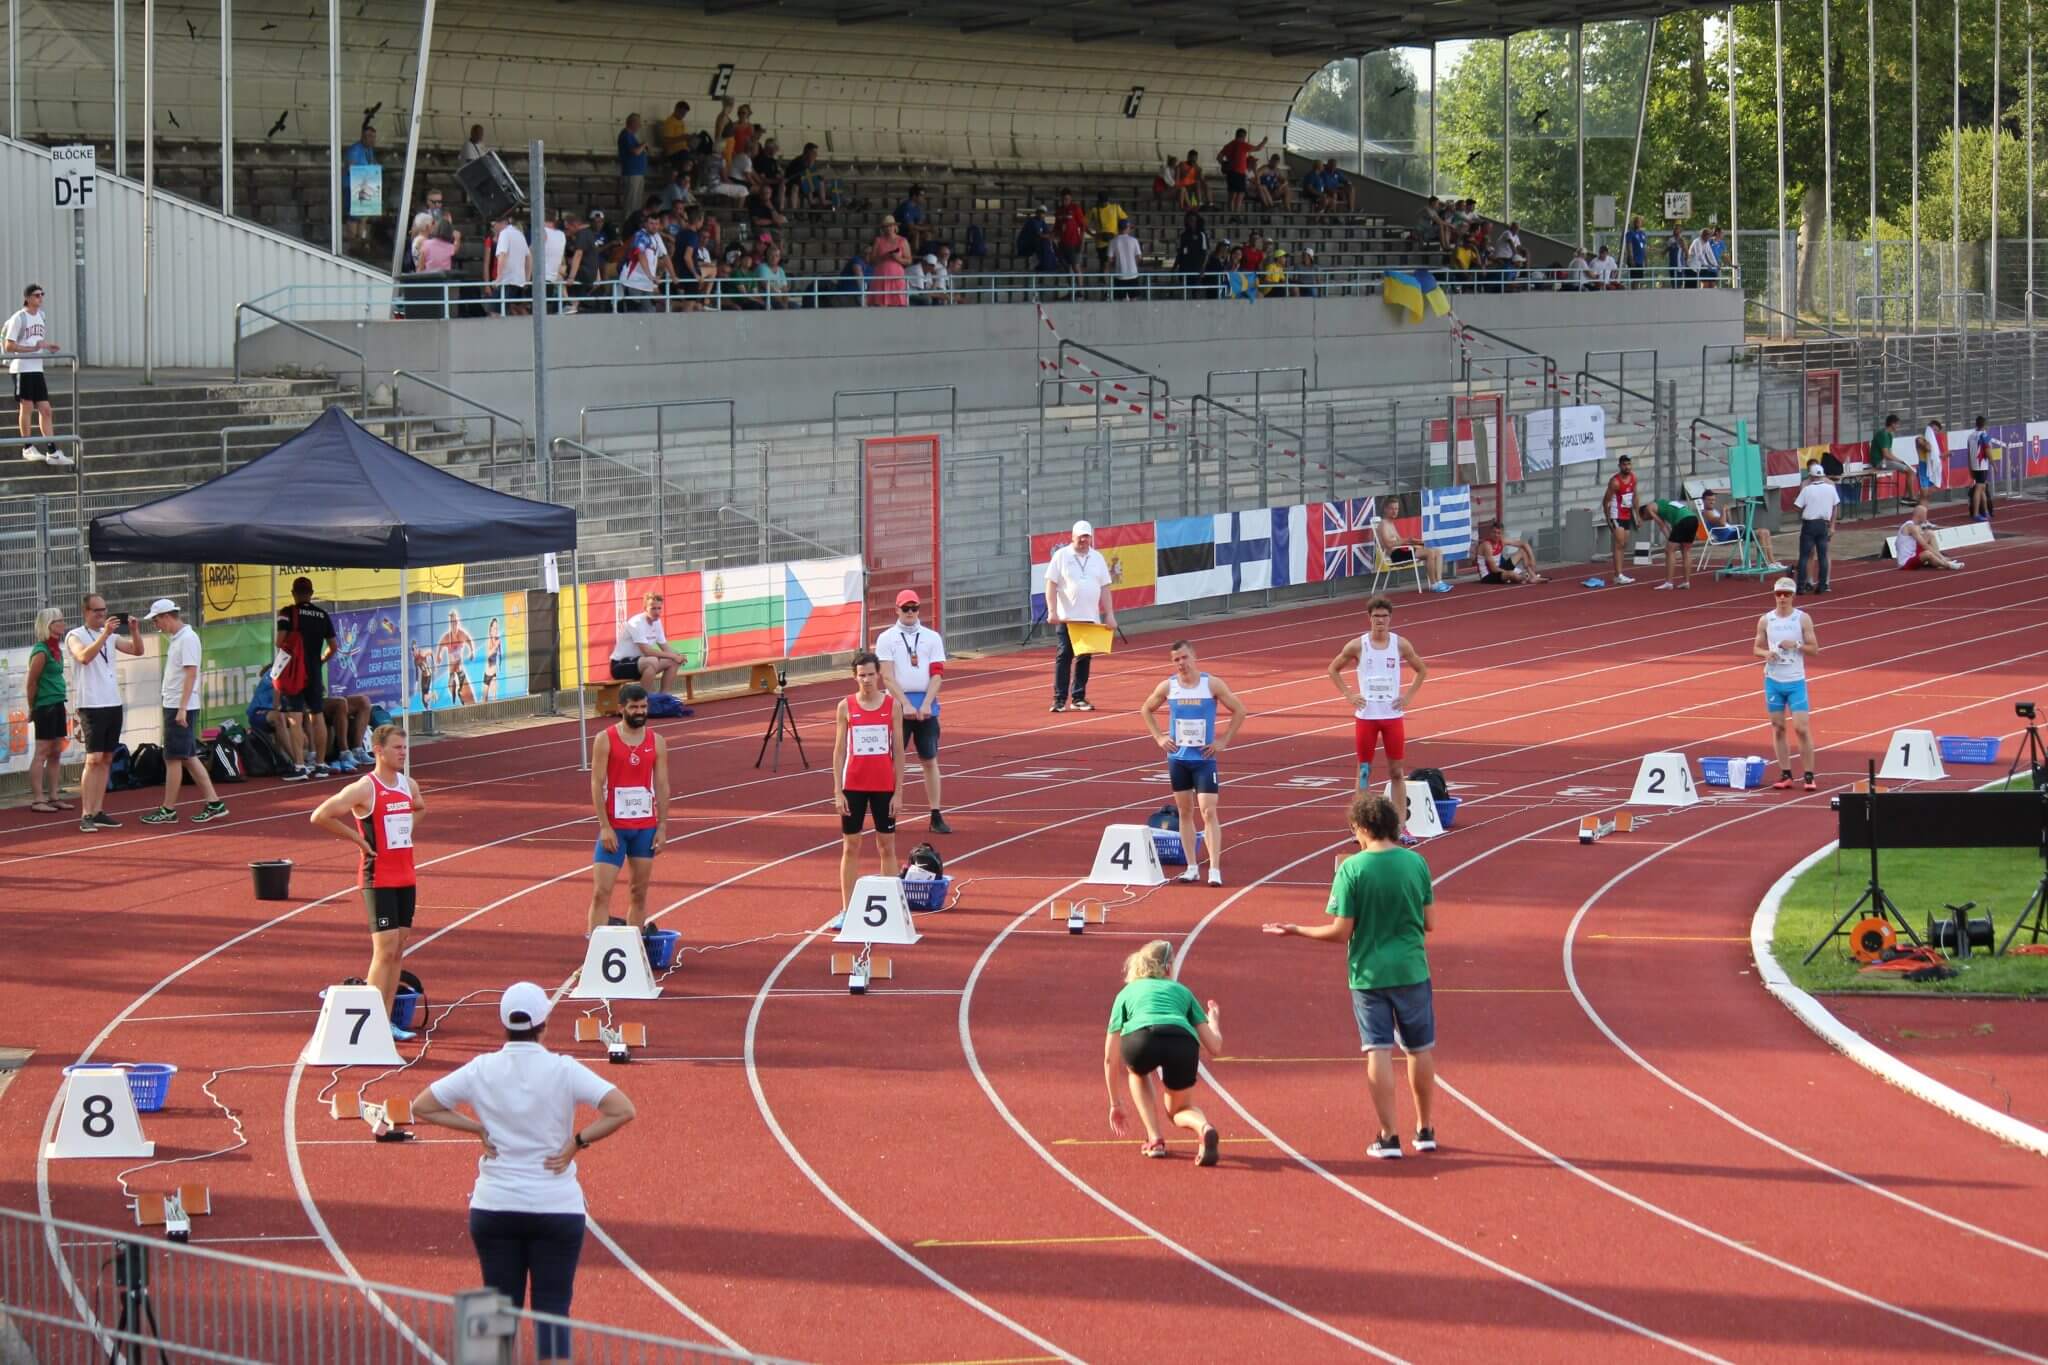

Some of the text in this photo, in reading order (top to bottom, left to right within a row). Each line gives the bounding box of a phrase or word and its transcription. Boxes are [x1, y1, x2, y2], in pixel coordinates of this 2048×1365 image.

[714, 67, 732, 96] E
[53, 148, 93, 160] BLÖCKE
[55, 176, 94, 206] D-F
[209, 565, 235, 586] ARAG
[1901, 743, 1911, 767] 1
[1648, 768, 1666, 794] 2
[1681, 767, 1690, 792] 2
[1425, 797, 1435, 824] 3
[1110, 841, 1133, 871] 4
[863, 895, 888, 927] 5
[602, 947, 627, 984] 6
[345, 1008, 371, 1045] 7
[82, 1094, 115, 1138] 8
